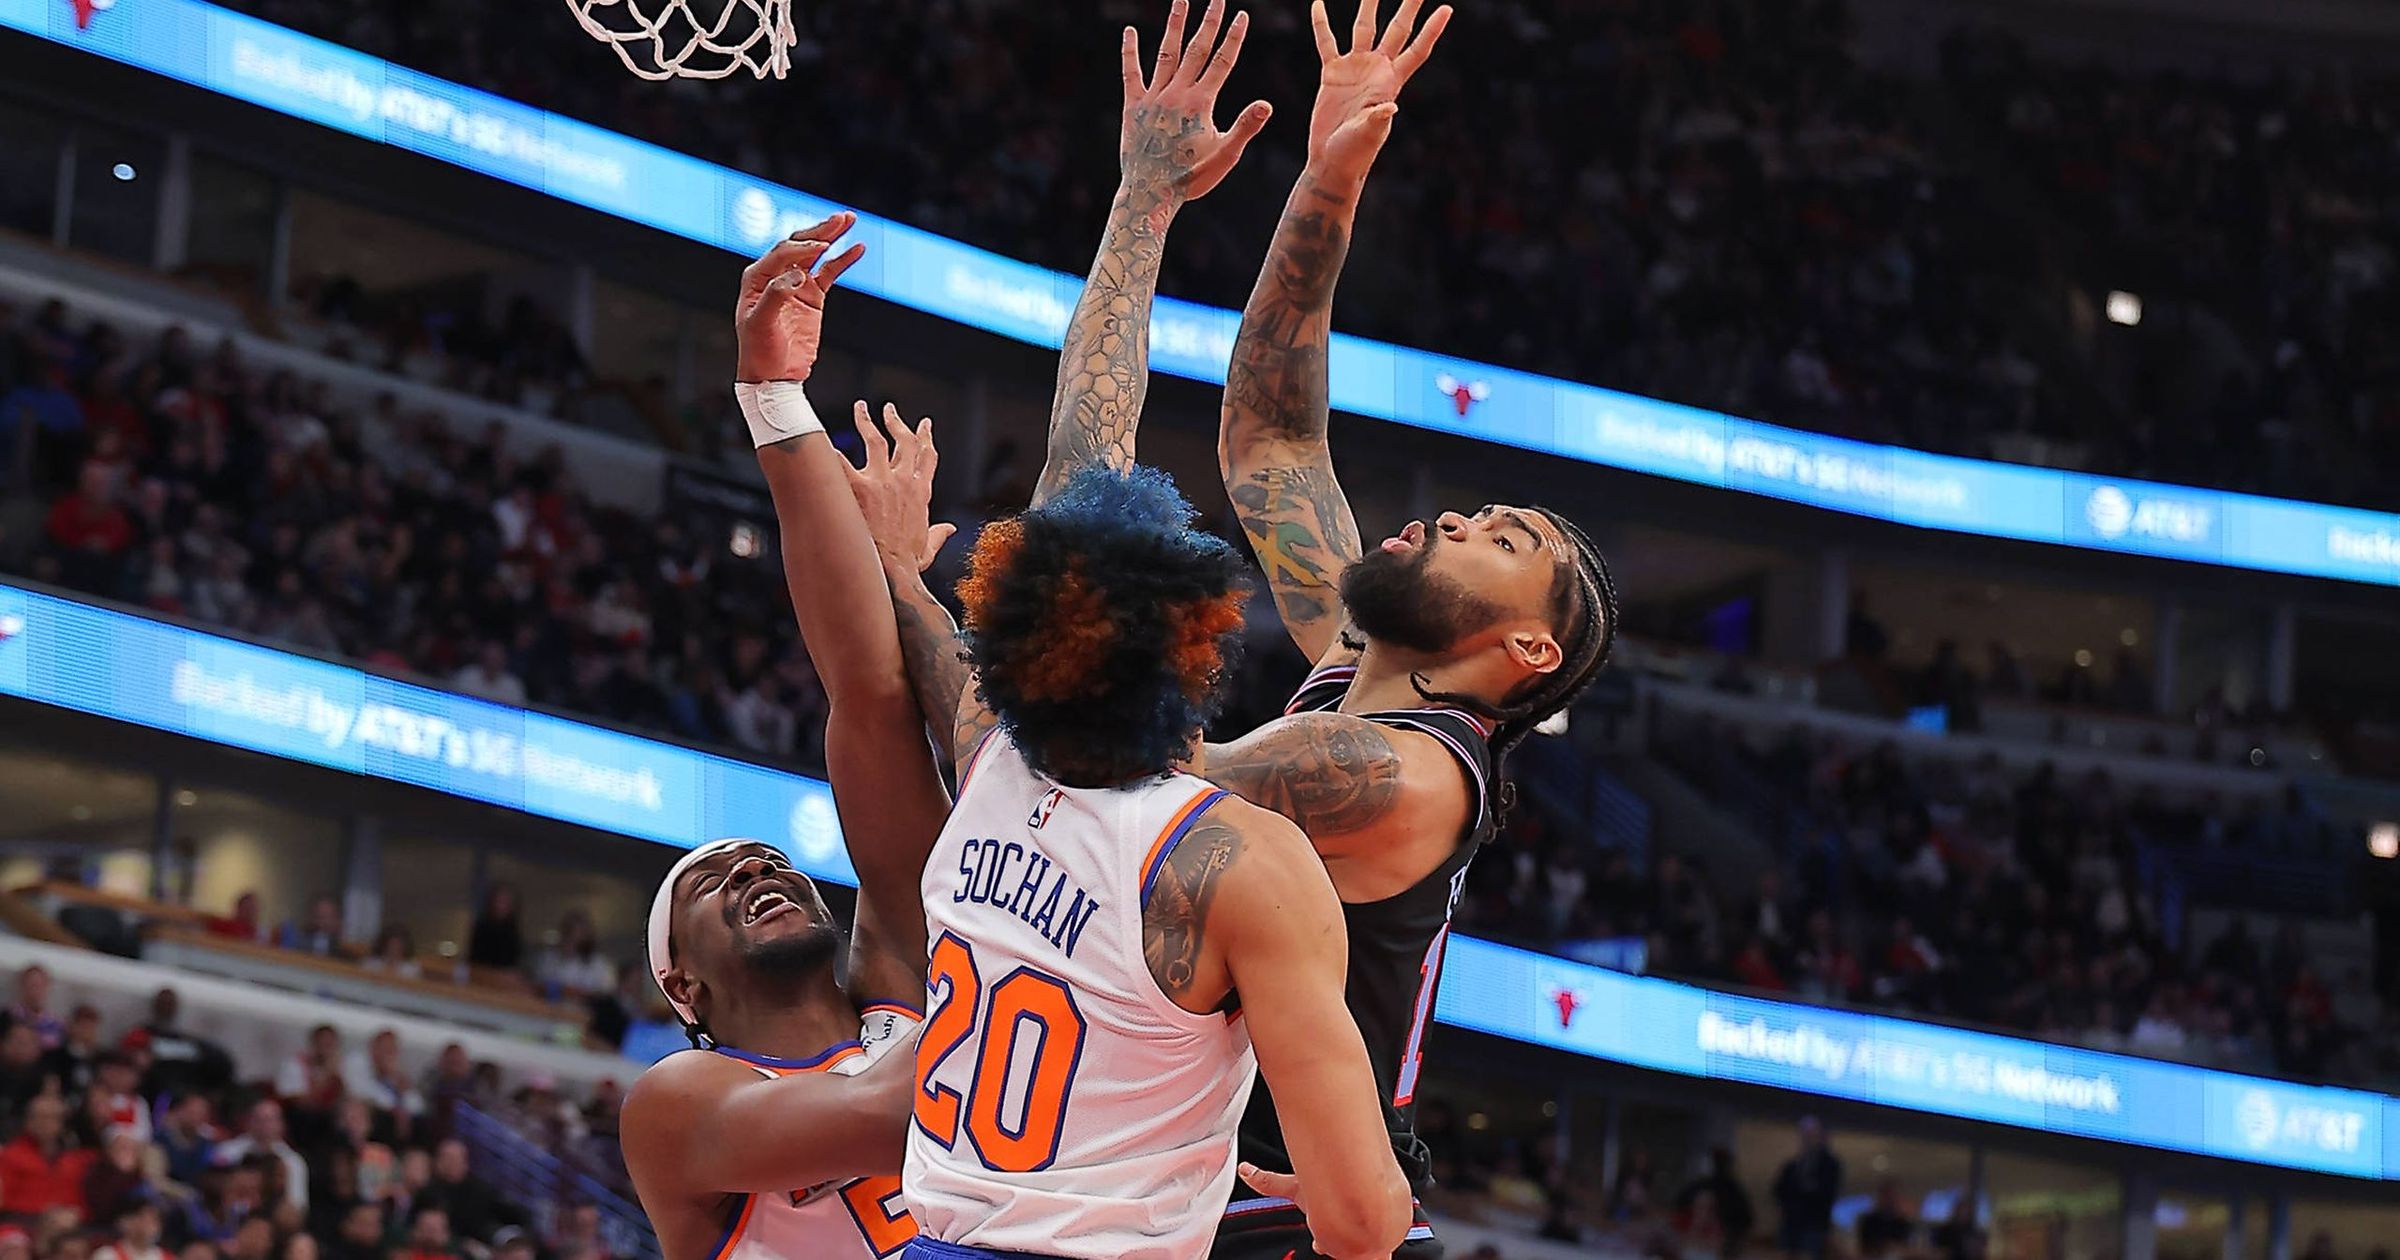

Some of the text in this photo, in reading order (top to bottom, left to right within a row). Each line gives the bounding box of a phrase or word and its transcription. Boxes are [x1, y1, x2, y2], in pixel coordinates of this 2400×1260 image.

[2131, 499, 2211, 543] AT&T
[171, 657, 305, 728] Backed
[306, 684, 353, 750] by
[353, 701, 470, 768] AT&T's
[520, 741, 664, 812] Network
[954, 838, 1099, 959] SOCHAN
[914, 928, 1087, 1173] 20
[1697, 1010, 1810, 1067] Backed
[1810, 1024, 1852, 1081] by
[1994, 1058, 2119, 1116] Network
[2280, 1106, 2366, 1154] AT&T
